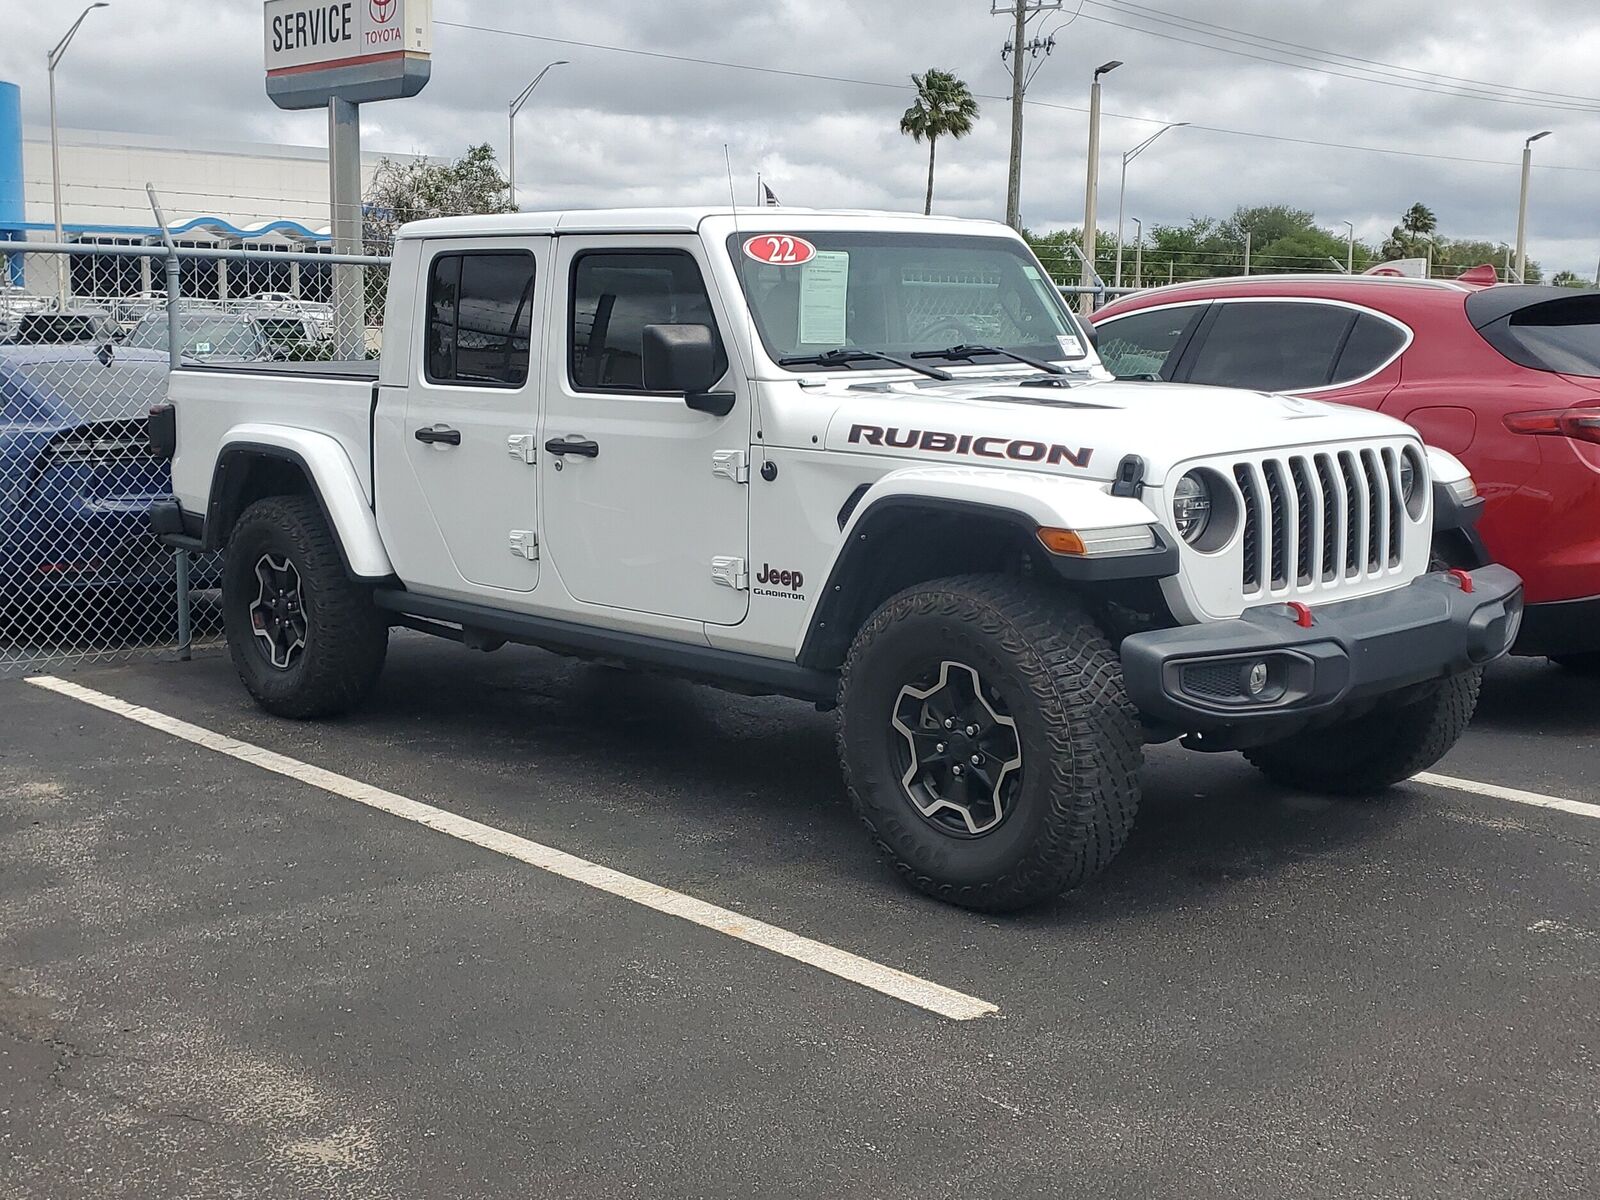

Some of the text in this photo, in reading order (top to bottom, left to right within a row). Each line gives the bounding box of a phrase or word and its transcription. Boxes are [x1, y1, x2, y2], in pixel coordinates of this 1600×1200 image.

[272, 3, 352, 52] SERVICE
[365, 27, 402, 45] TOYOTA
[766, 237, 797, 262] 22
[847, 423, 1095, 469] RUBICON
[756, 562, 804, 592] Jeep
[753, 588, 806, 601] GLADIATOR
